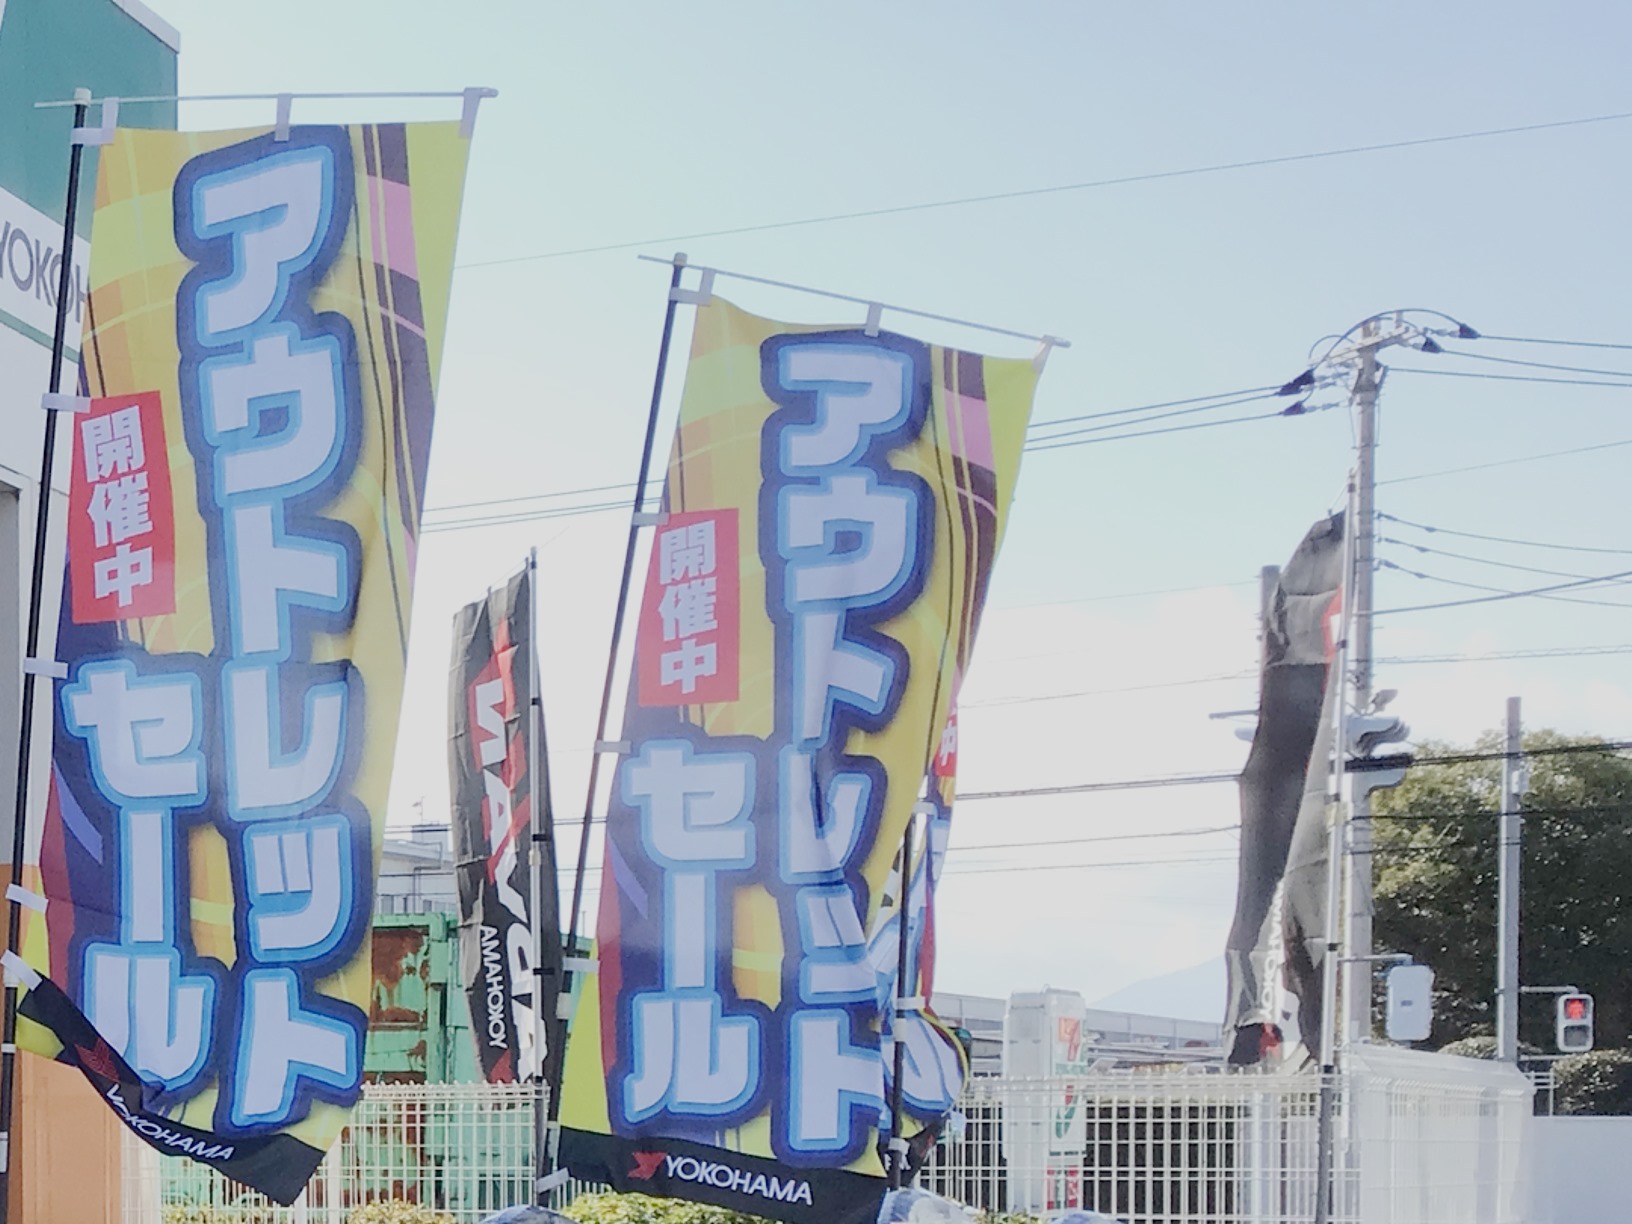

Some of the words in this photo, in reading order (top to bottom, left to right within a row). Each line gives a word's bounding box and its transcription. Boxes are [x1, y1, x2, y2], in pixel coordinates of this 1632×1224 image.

[79, 404, 155, 608] 開催中
[201, 157, 349, 1118] アウトレット
[658, 519, 718, 695] 開催中
[70, 666, 208, 1082] セール
[784, 350, 908, 1141] アウトレット
[630, 746, 751, 1113] セール
[106, 1082, 236, 1161] YOKOHAMA
[666, 1153, 814, 1206] YOKOHAMA
